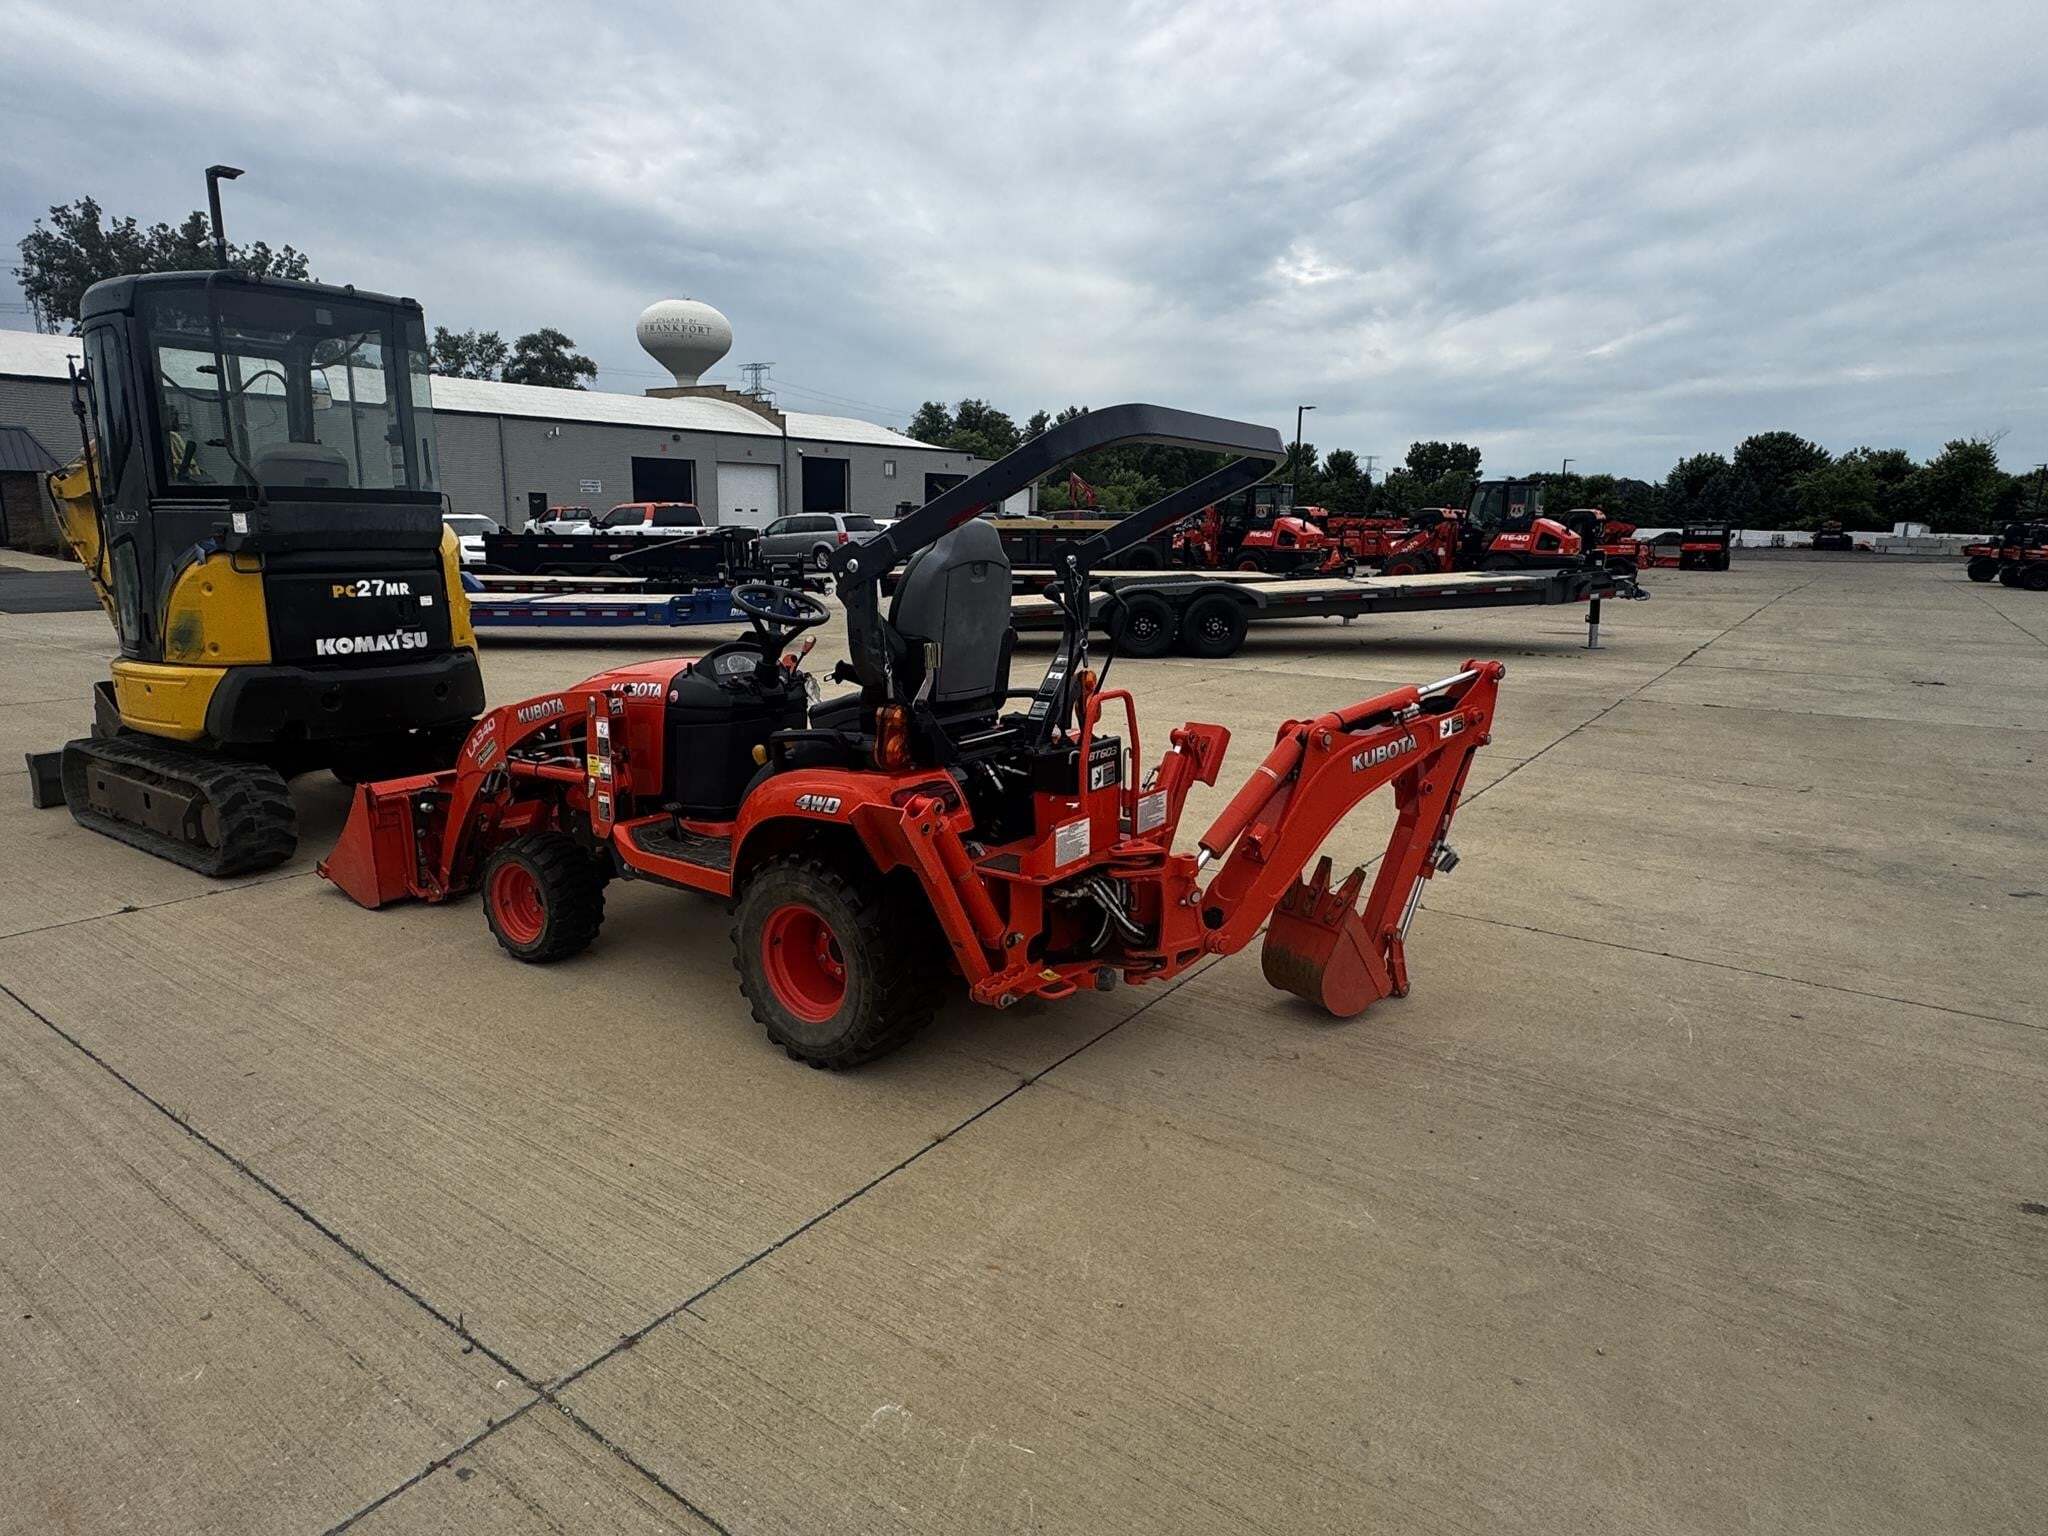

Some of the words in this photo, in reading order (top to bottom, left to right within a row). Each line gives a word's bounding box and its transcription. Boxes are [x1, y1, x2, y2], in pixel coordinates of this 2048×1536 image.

[644, 324, 712, 335] FRANKFORT
[332, 579, 410, 598] PC27MR
[316, 629, 428, 656] KOMATSU
[517, 698, 565, 724] KUBOTA
[466, 717, 496, 759] LA340
[1351, 734, 1418, 773] KUBOTA
[794, 793, 842, 814] 4WD
